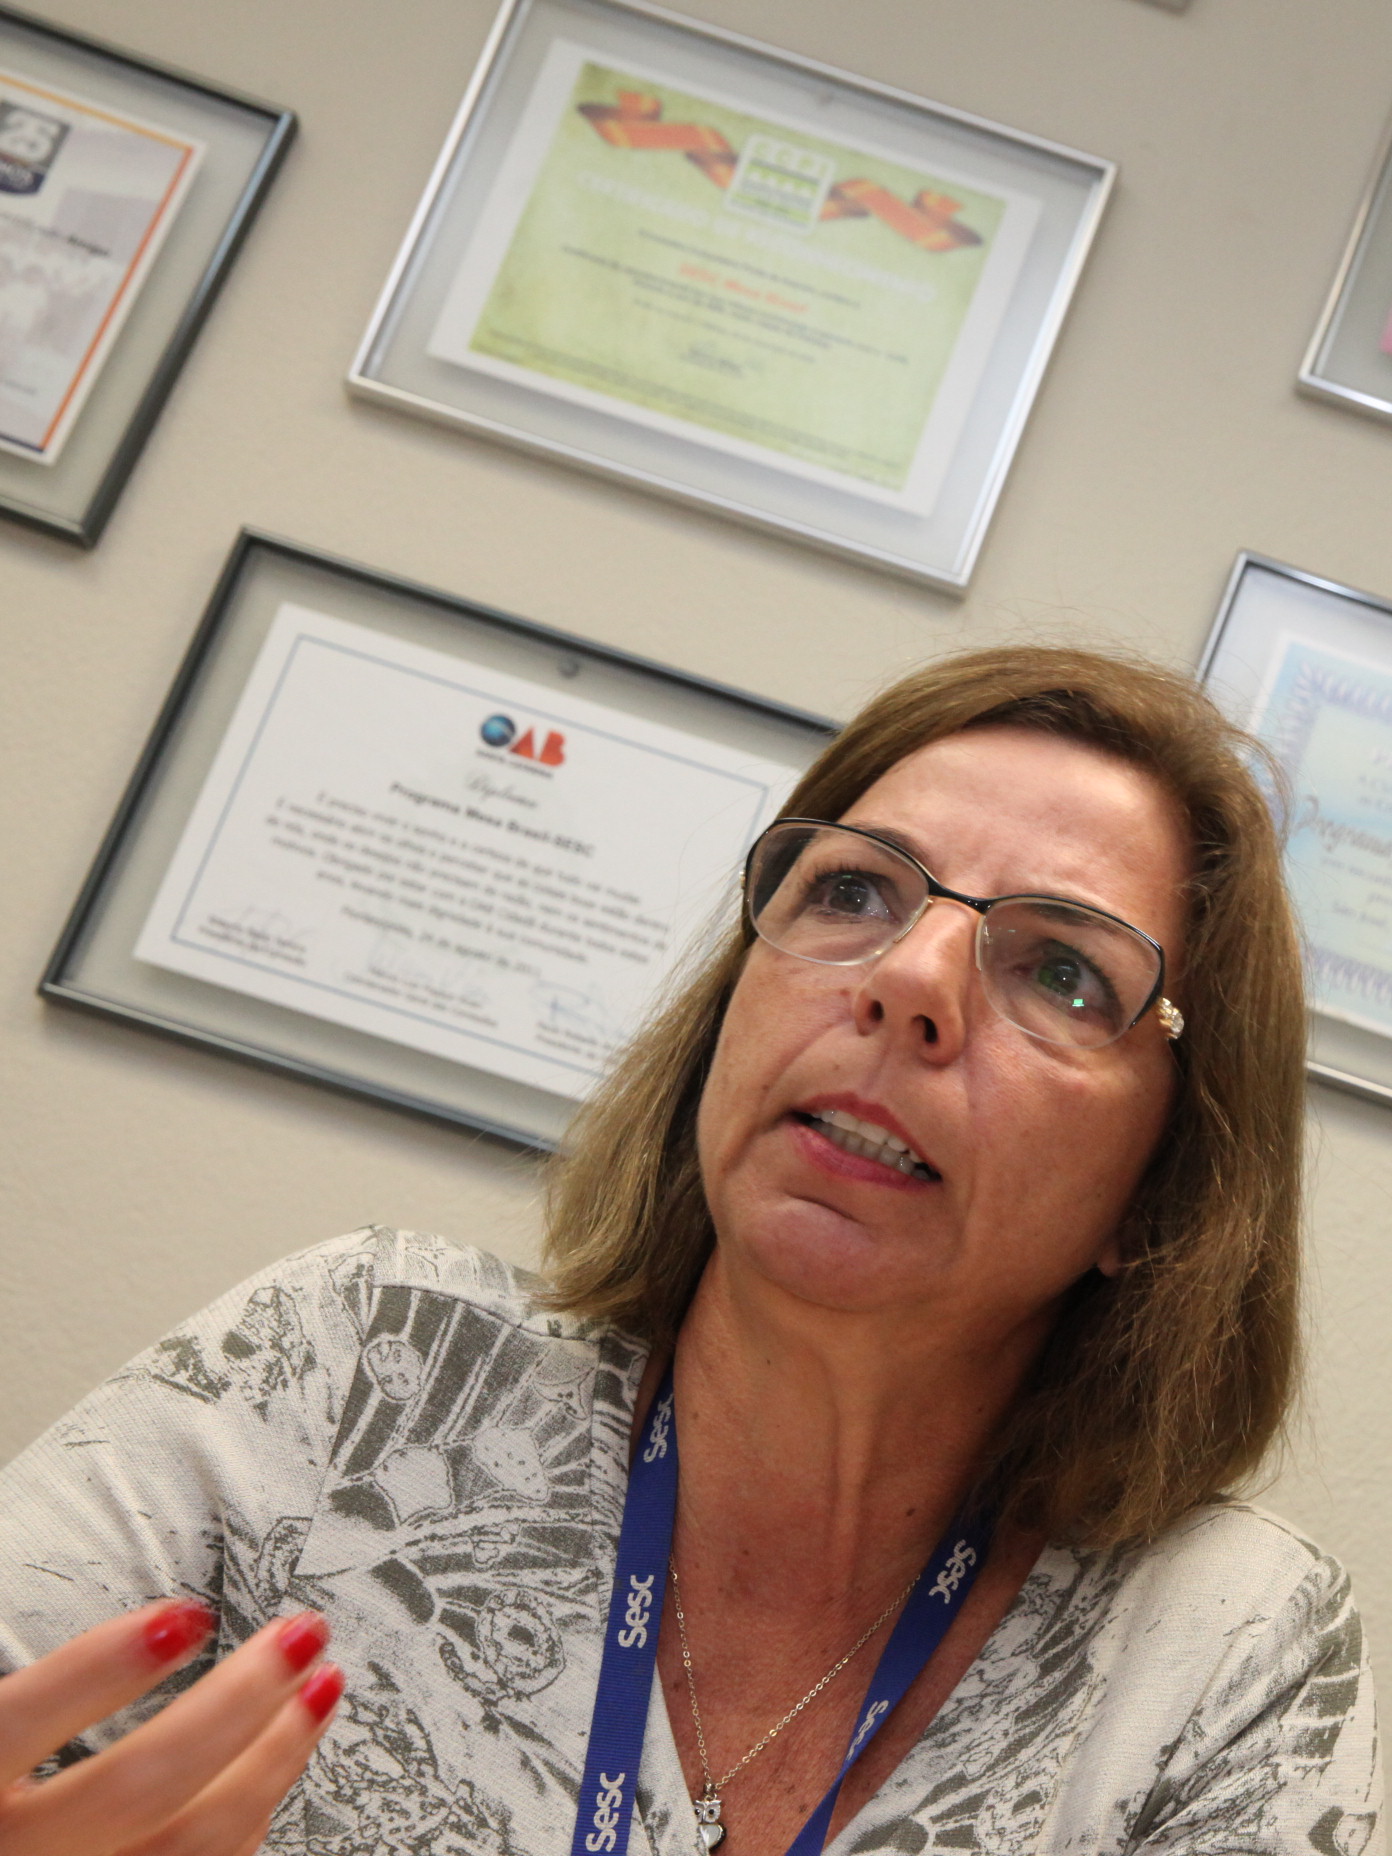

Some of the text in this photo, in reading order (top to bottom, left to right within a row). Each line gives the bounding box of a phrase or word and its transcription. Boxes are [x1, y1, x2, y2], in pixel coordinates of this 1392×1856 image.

[478, 712, 570, 767] OAB
[388, 782, 461, 814] Programa
[464, 806, 503, 828] Mesa
[927, 1538, 978, 1605] Sesc
[618, 1573, 656, 1649] Sesc
[585, 1771, 626, 1852] Sesc
